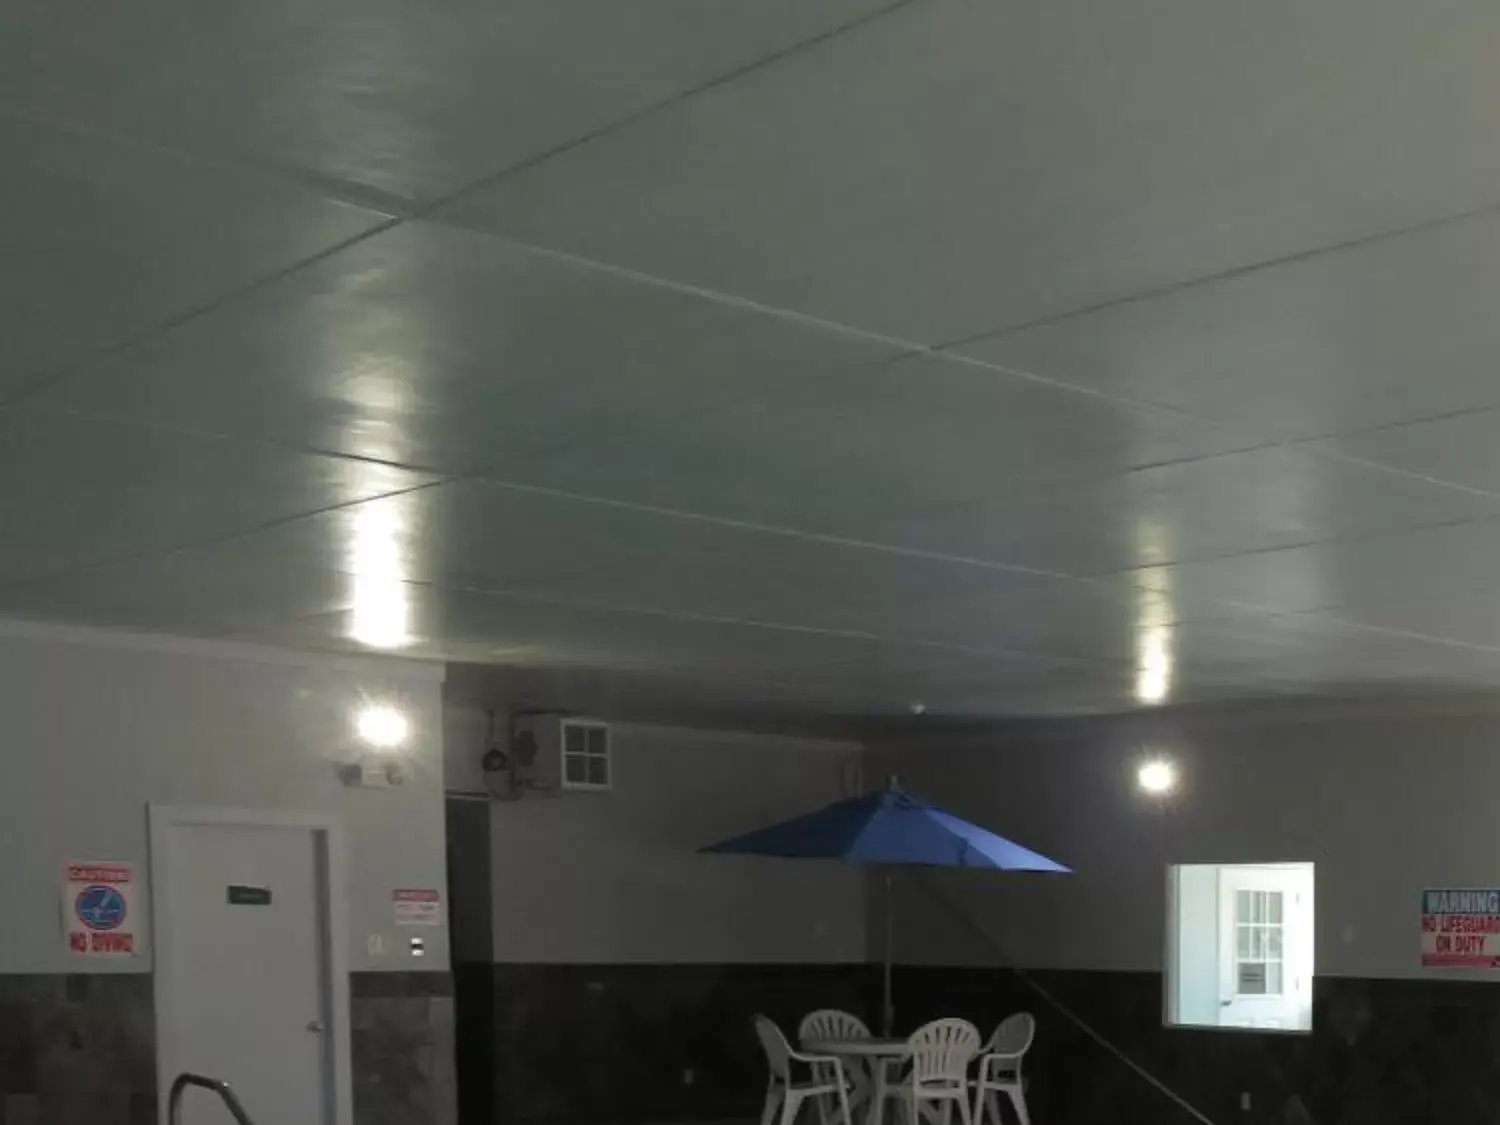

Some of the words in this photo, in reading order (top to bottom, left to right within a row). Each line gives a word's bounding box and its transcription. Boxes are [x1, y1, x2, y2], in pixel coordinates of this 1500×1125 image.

[1426, 891, 1500, 912] WARNING
[1422, 915, 1436, 932] NO
[70, 932, 87, 952] NO
[92, 932, 133, 952] DIVING
[1436, 934, 1451, 952] ON
[1455, 934, 1485, 953] DUTY
